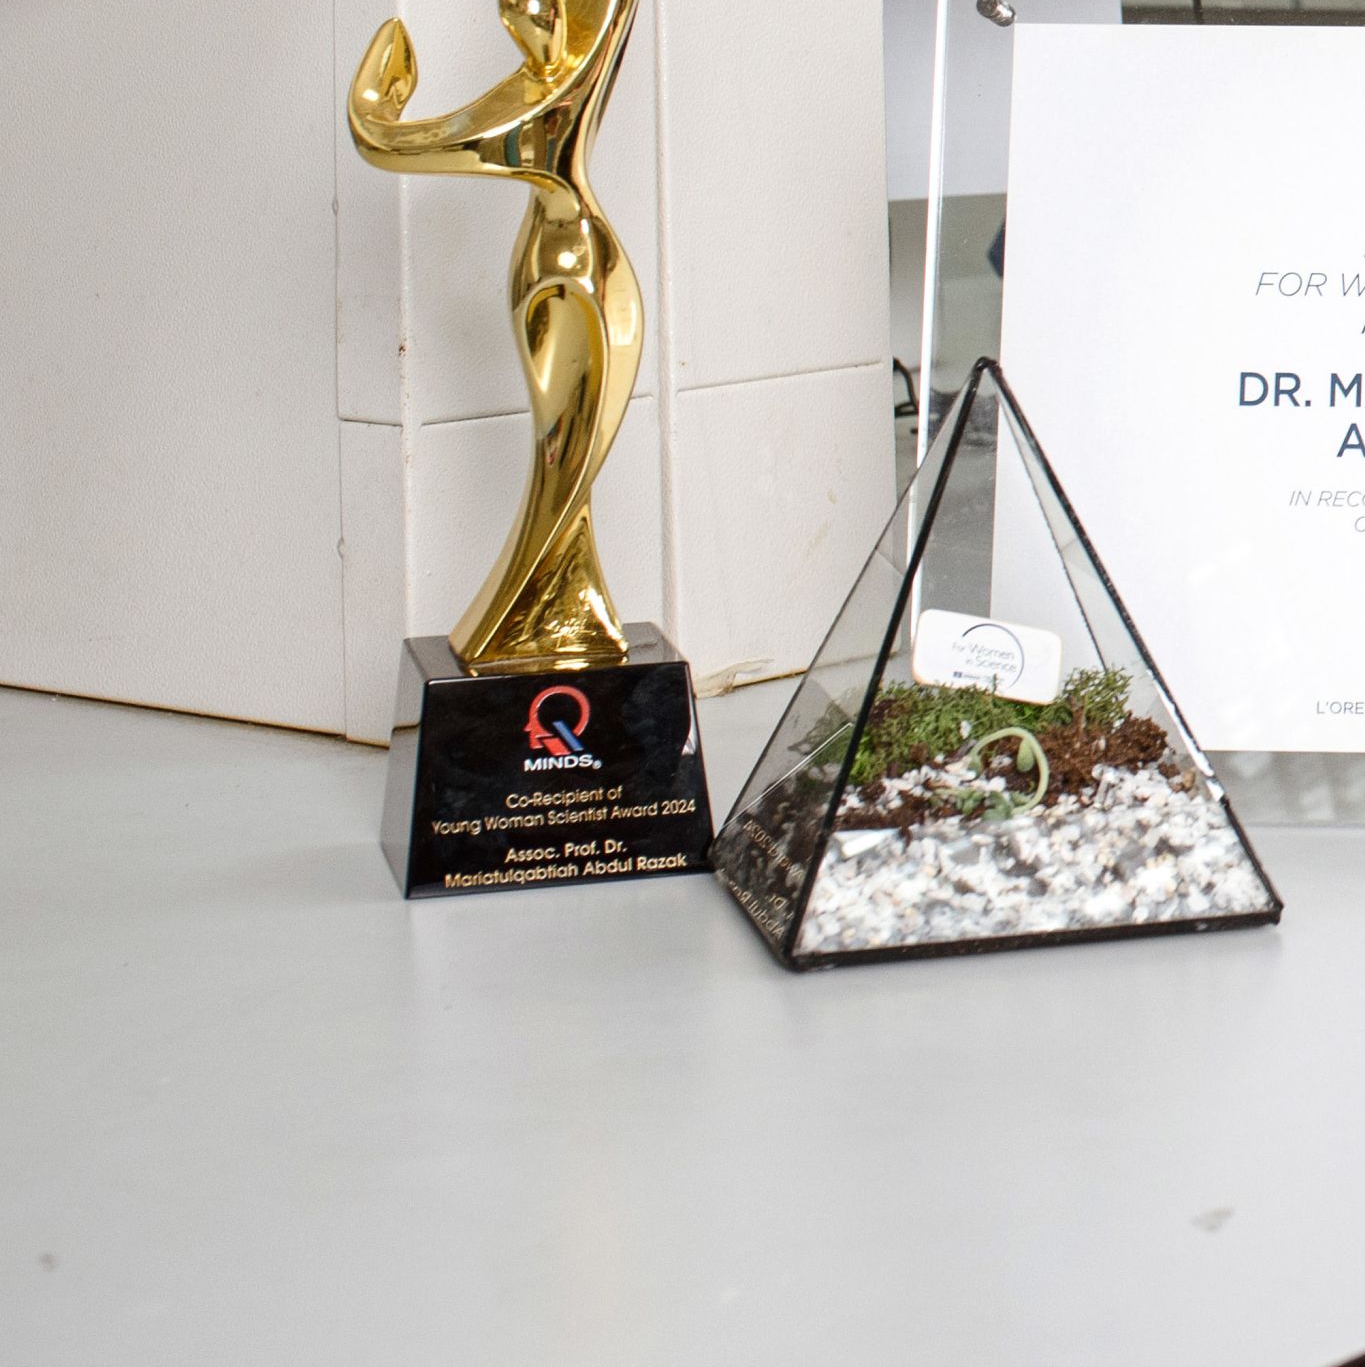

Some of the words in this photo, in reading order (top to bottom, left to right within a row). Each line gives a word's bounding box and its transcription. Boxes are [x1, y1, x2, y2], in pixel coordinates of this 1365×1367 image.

[1255, 272, 1328, 298] FOR
[1238, 372, 1312, 409] DR.
[1288, 490, 1312, 508] IN
[505, 786, 603, 809] Co-Recipient
[606, 785, 624, 800] of
[431, 817, 482, 836] Young
[485, 813, 546, 831] Woman
[547, 804, 608, 824] Scientist
[611, 802, 659, 820] Award
[661, 799, 697, 815] 2024
[504, 846, 560, 864] Assoc.
[564, 842, 601, 859] Prof.
[604, 839, 628, 855] Dr.
[444, 859, 579, 889] Mariatulqabtiah
[582, 855, 633, 877] Abdul
[636, 852, 688, 872] Razak
